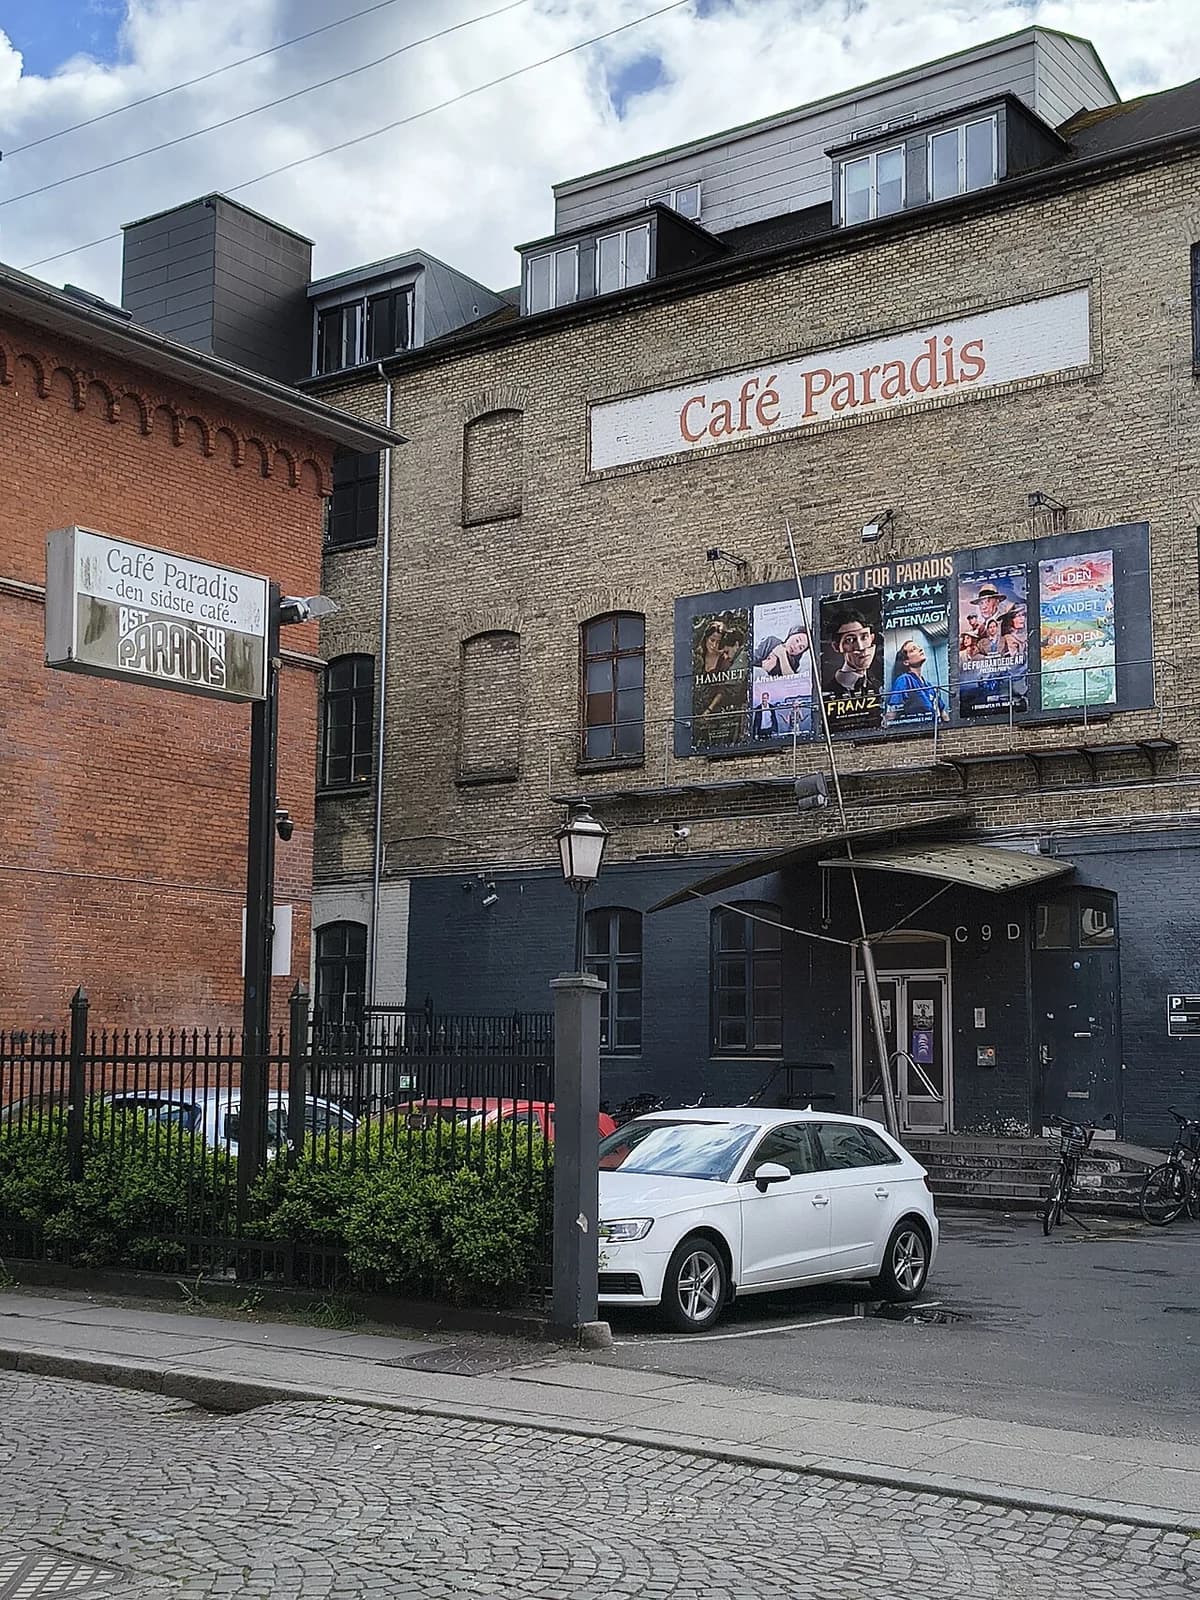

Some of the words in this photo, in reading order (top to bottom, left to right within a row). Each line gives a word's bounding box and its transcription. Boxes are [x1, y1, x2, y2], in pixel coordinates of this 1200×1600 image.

[678, 374, 781, 443] Café
[800, 335, 987, 419] Paradis
[107, 548, 154, 581] Café
[163, 562, 239, 603] Paradis
[833, 571, 860, 593] ØST
[864, 566, 890, 589] FOR
[896, 556, 954, 584] PARADIS
[1058, 569, 1092, 585] ILDEN
[150, 589, 194, 614] sidste
[1052, 600, 1098, 615] VANDET
[885, 611, 946, 630] AFTENVAGT
[1053, 631, 1099, 646] JORDEN
[119, 621, 226, 687] PARADIS
[695, 668, 745, 685] HAMNET
[827, 697, 880, 716] FRANZ
[1172, 997, 1182, 1009] P
